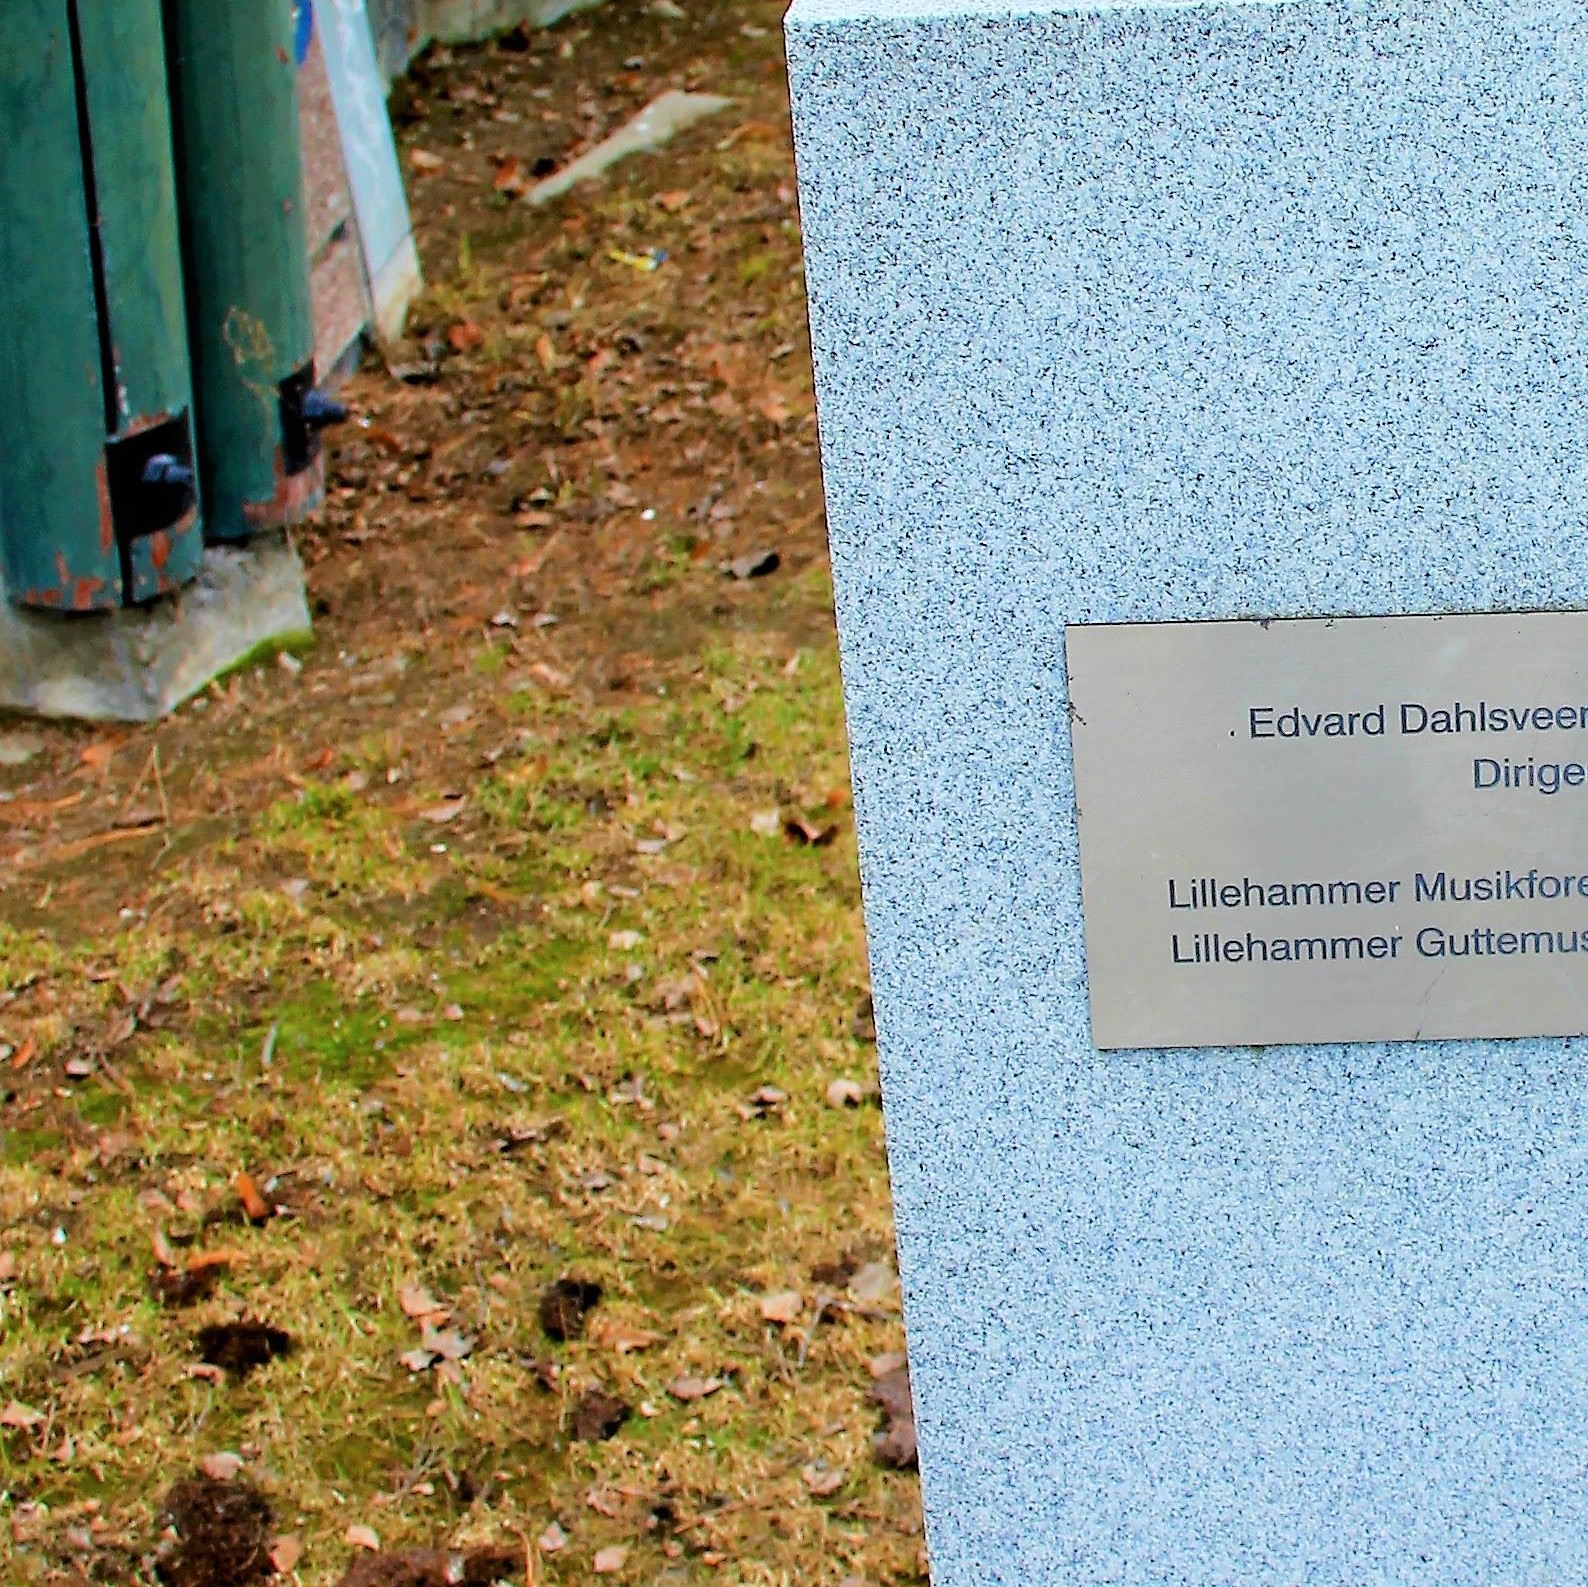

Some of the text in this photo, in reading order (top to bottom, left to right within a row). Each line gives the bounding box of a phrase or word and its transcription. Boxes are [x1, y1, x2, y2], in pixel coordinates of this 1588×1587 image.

[1249, 704, 1385, 739] Edvard
[1168, 877, 1401, 910] Lillehammer
[1172, 932, 1404, 964] Lillehammer
